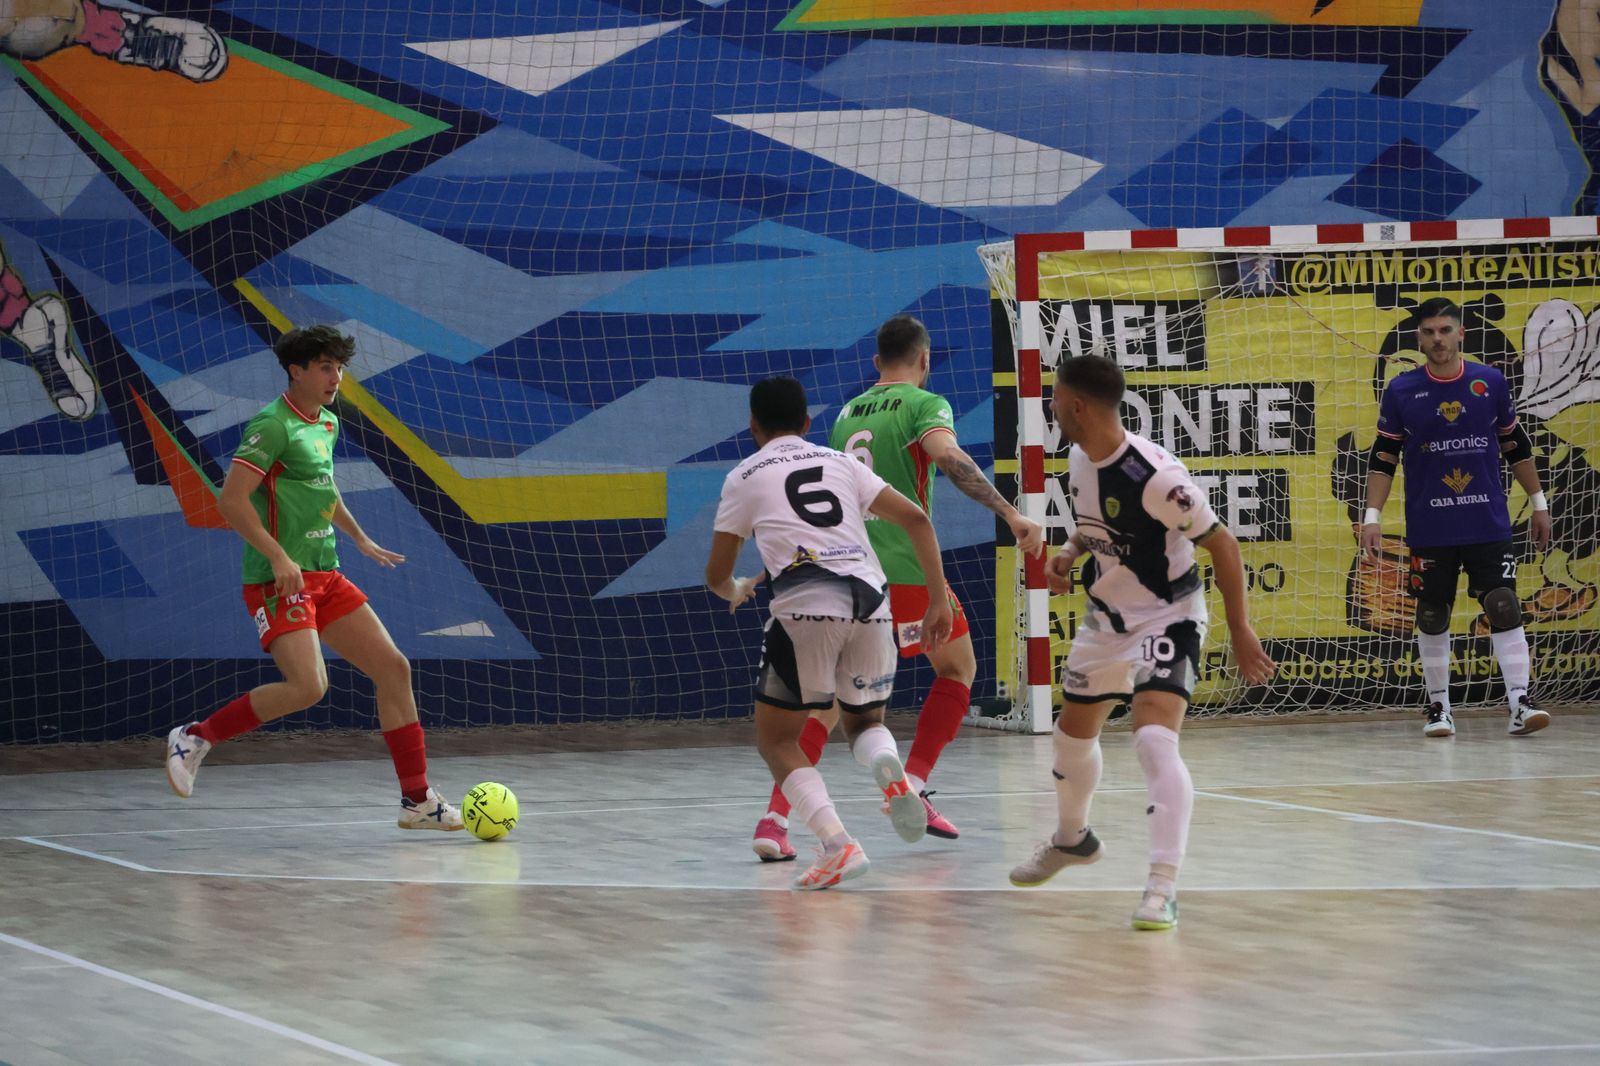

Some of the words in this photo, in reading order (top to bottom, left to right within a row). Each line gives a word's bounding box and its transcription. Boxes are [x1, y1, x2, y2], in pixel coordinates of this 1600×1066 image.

[1290, 244, 1600, 296] @MMonteAlist
[1429, 434, 1489, 453] euronics
[741, 456, 790, 480] DEPORCYL
[784, 465, 844, 528] 6
[1429, 498, 1455, 508] CAJA
[1456, 493, 1490, 505] RURAL
[1141, 635, 1176, 662] 10
